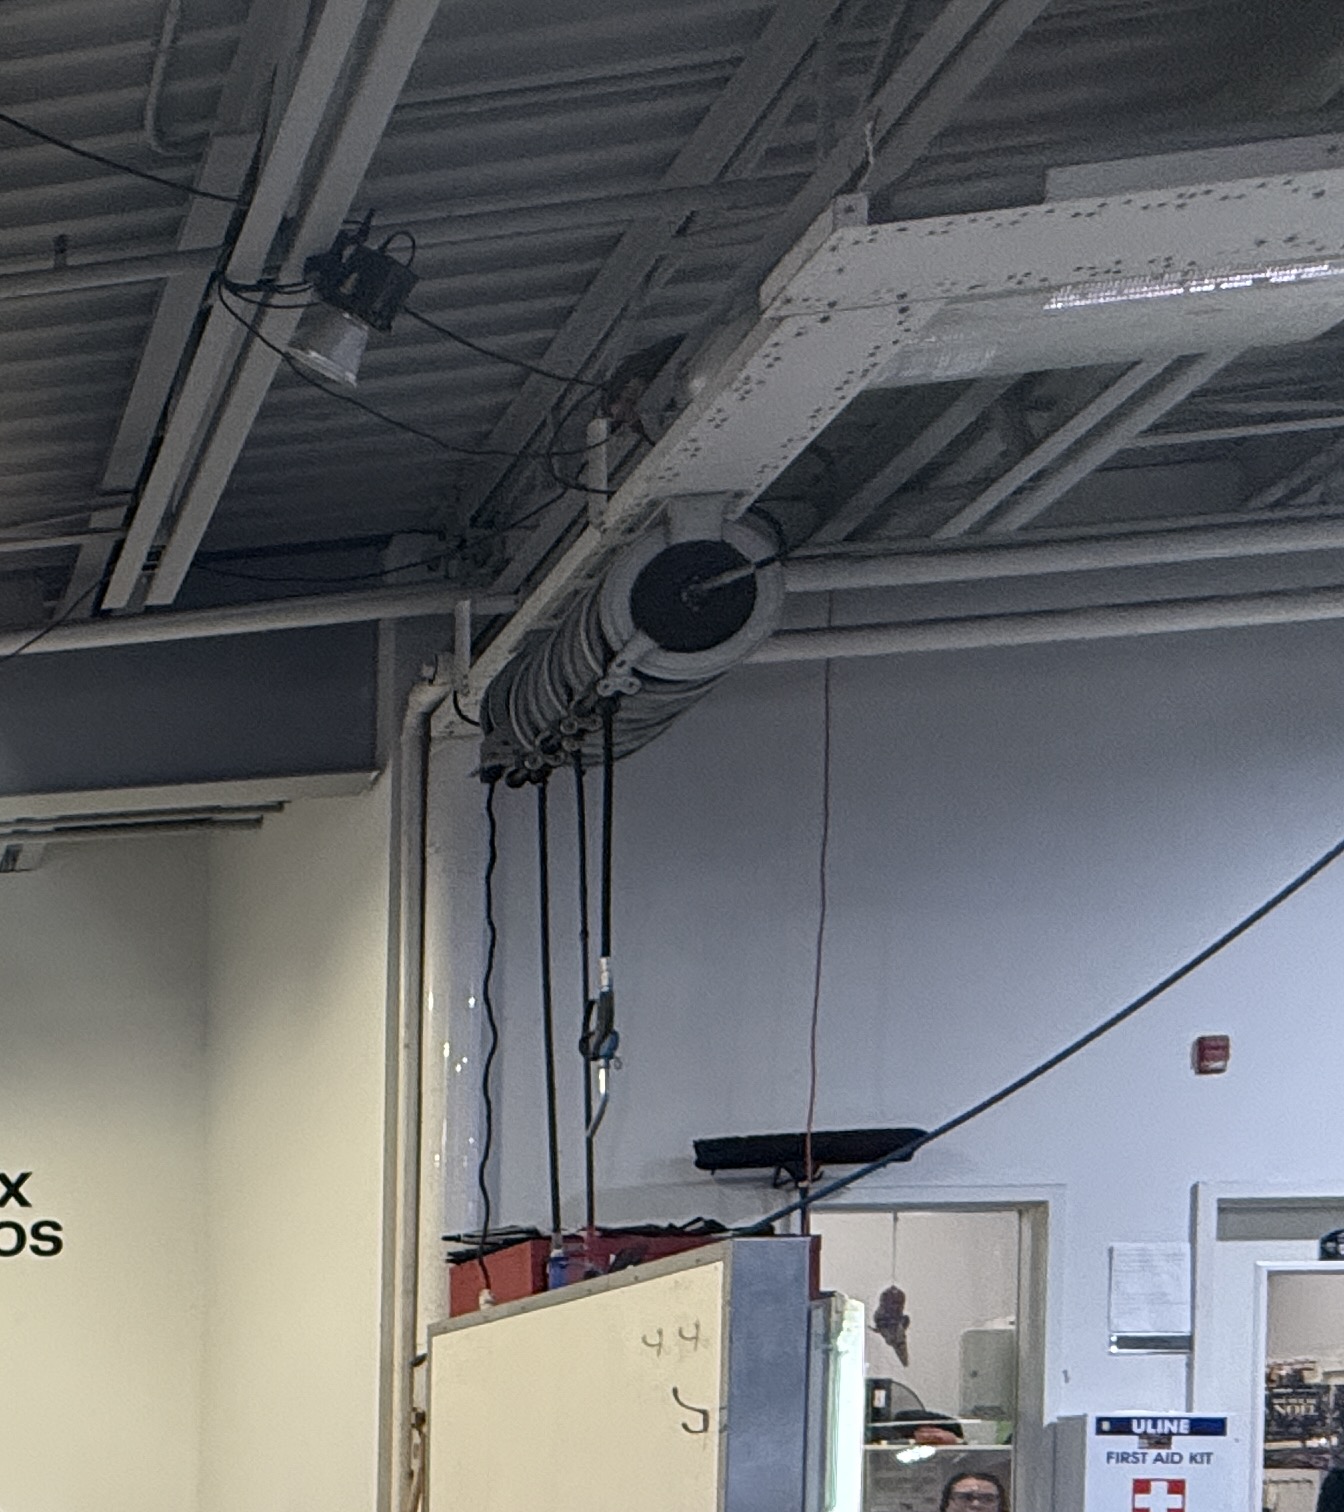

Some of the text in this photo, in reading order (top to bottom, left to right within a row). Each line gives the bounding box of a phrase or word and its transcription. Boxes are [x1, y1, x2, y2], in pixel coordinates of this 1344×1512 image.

[1130, 1418, 1191, 1435] ULINE
[1105, 1451, 1214, 1466] FIRST AID KIT
